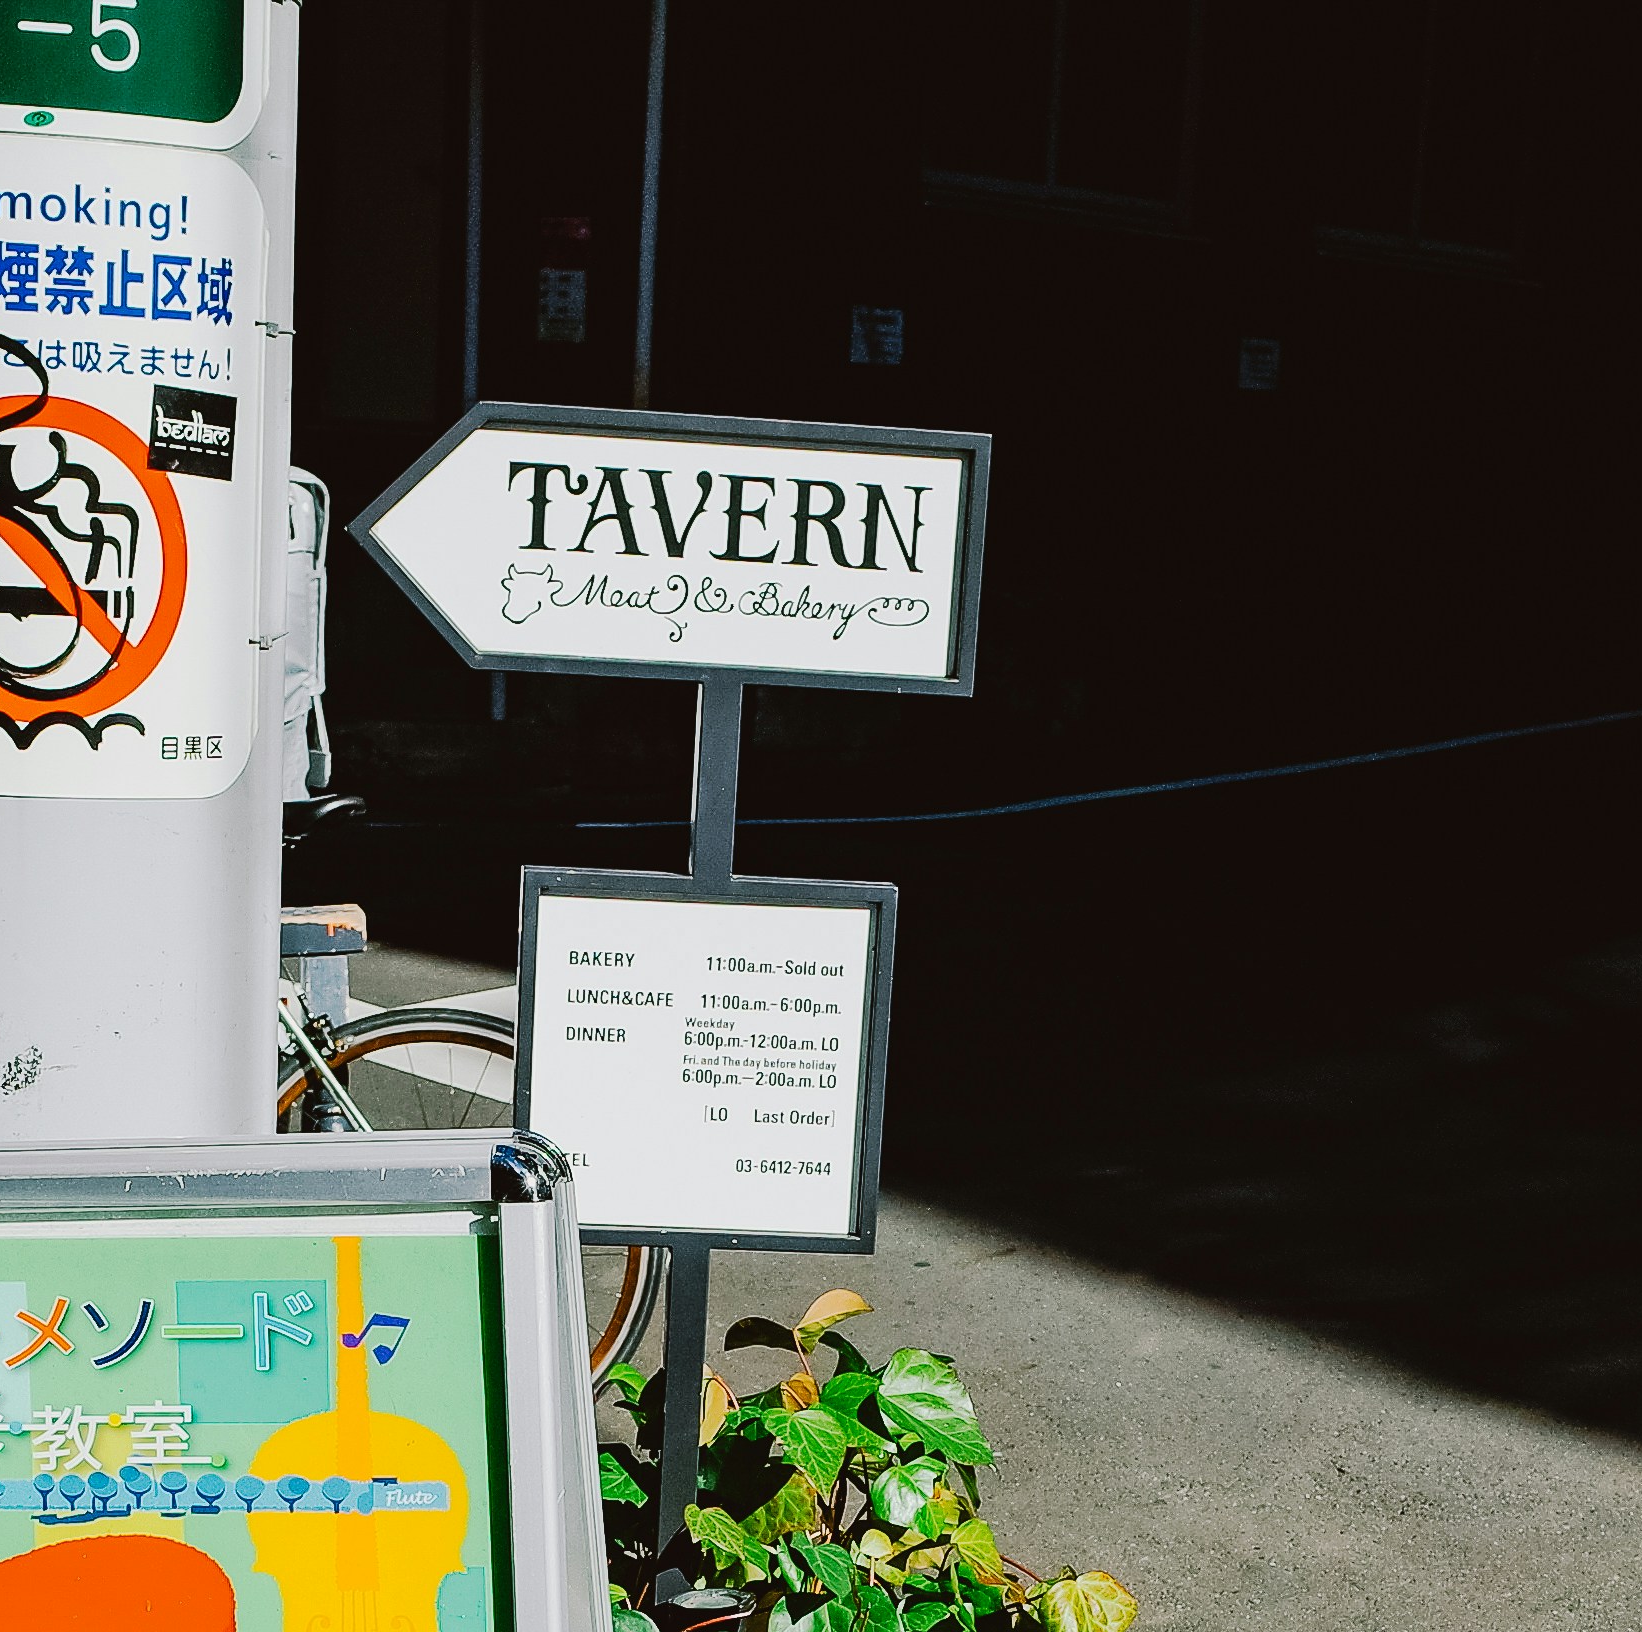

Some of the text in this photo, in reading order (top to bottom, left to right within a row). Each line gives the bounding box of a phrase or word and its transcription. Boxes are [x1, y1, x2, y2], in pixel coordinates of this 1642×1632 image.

[508, 461, 933, 573] TAVERN
[562, 573, 663, 612] Meat
[162, 736, 223, 760] 目黒区
[570, 951, 635, 967] BAKERY
[821, 965, 843, 976] out
[568, 989, 673, 1007] LUNCH&CAFE
[684, 1017, 735, 1031] Weekday
[567, 1027, 625, 1042] DINNER
[821, 1037, 839, 1052] LO
[742, 1057, 761, 1070] day
[763, 1058, 796, 1069] before
[799, 1060, 837, 1073] holiday
[819, 1074, 837, 1089] LO
[755, 1109, 784, 1124] Last
[736, 1159, 830, 1175] 03-6412-7644
[383, 1486, 440, 1511] Flute
